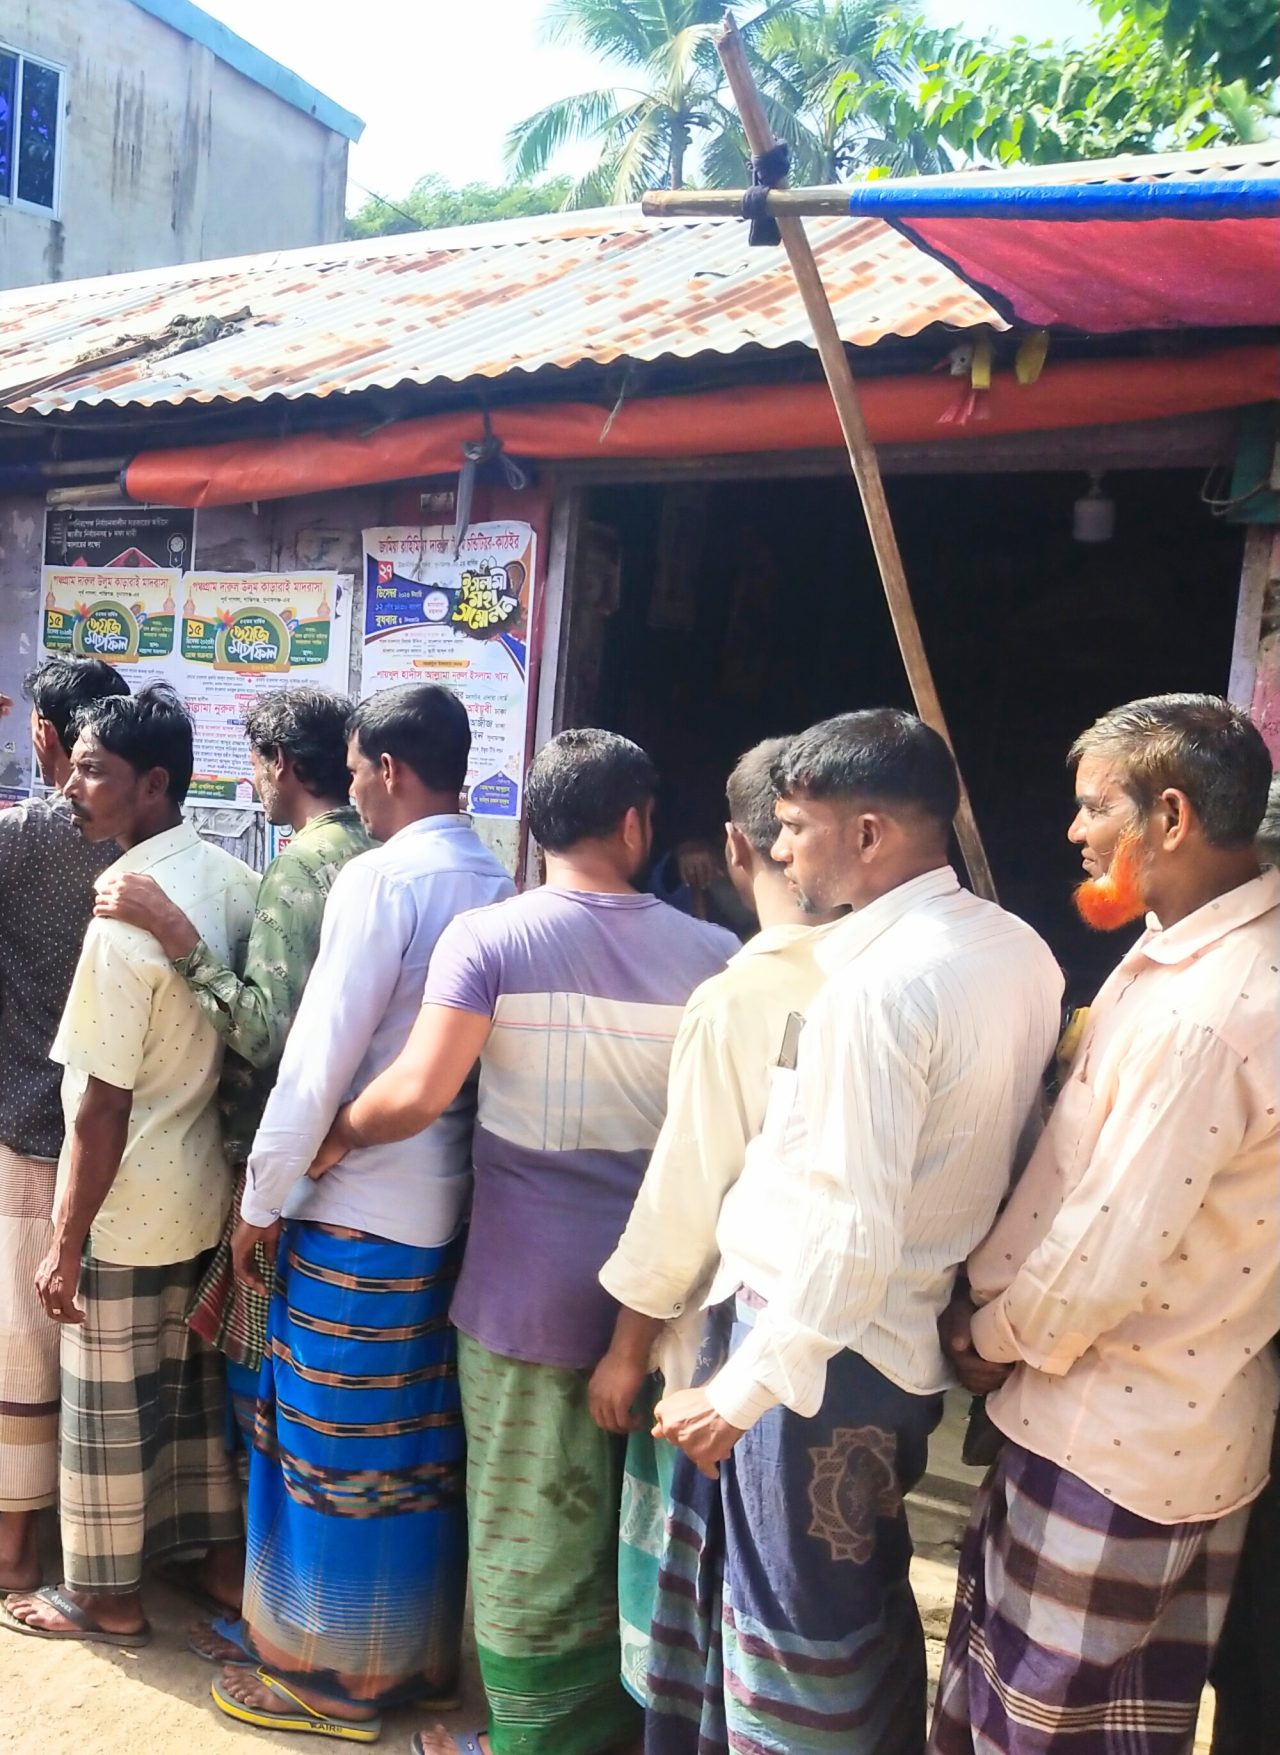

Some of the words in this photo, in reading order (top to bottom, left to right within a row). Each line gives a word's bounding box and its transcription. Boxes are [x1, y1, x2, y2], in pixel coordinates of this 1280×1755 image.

[379, 565, 392, 579] ২৭
[219, 581, 238, 592] দারুল
[241, 580, 259, 594] উলুম
[293, 582, 323, 592] মাদরাসা
[49, 616, 61, 625] ১৫
[375, 614, 398, 628] বুধবার
[188, 624, 203, 634] ১৫
[228, 640, 278, 663] মাহফিল
